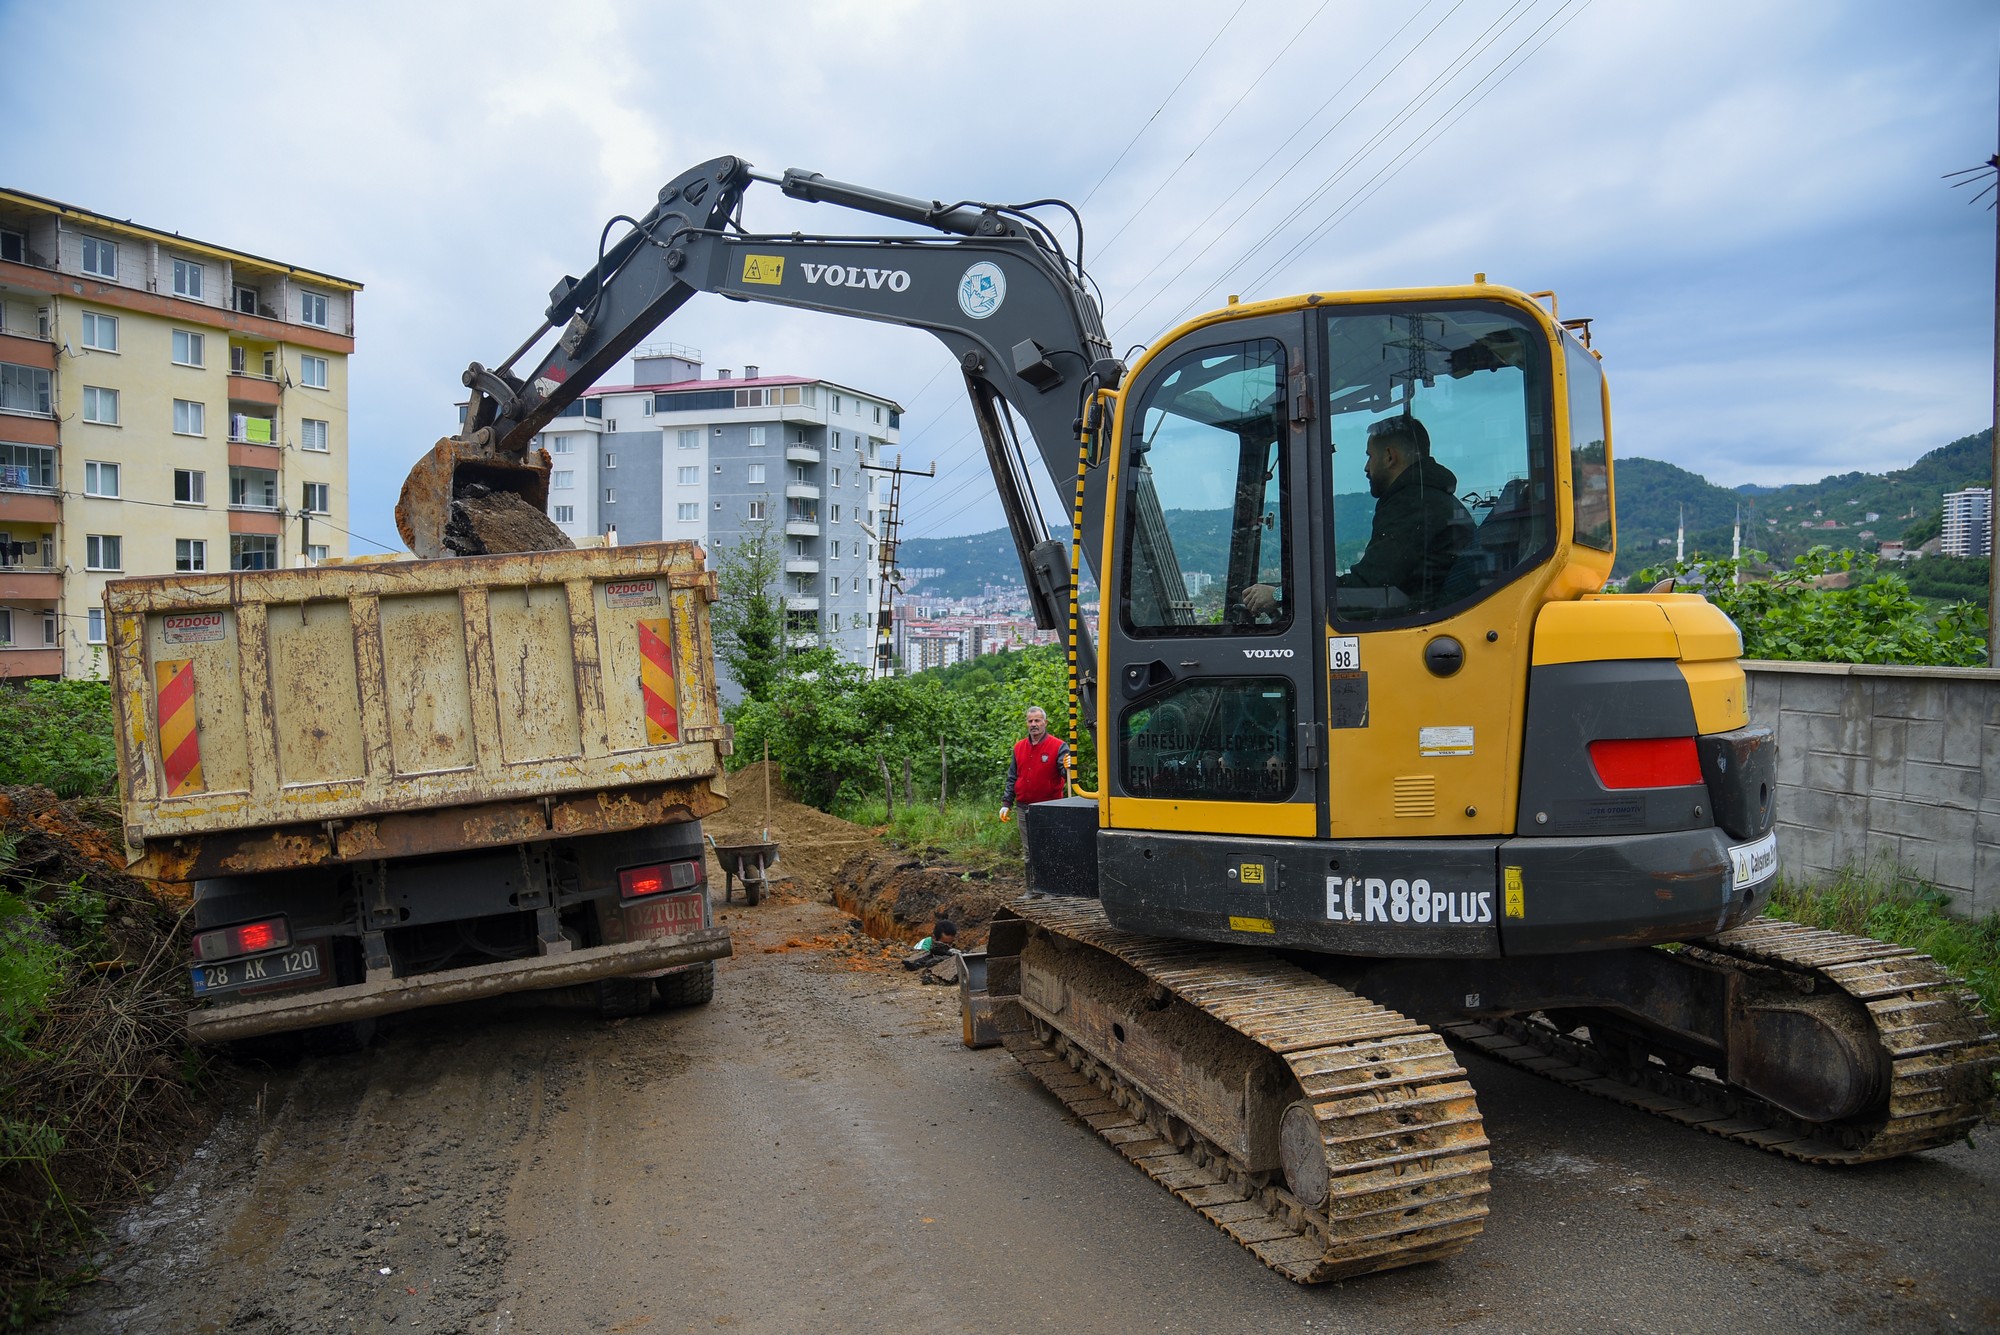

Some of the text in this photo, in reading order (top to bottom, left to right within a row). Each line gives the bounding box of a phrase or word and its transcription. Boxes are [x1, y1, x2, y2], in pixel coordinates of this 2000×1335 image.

[800, 263, 911, 293] VOLVO
[607, 582, 654, 595] ÖZDOĞU
[166, 614, 221, 629] ÖZDOĞU
[1242, 649, 1294, 659] VOLVO
[1335, 651, 1351, 668] 98
[205, 950, 312, 988] 28 AK 120
